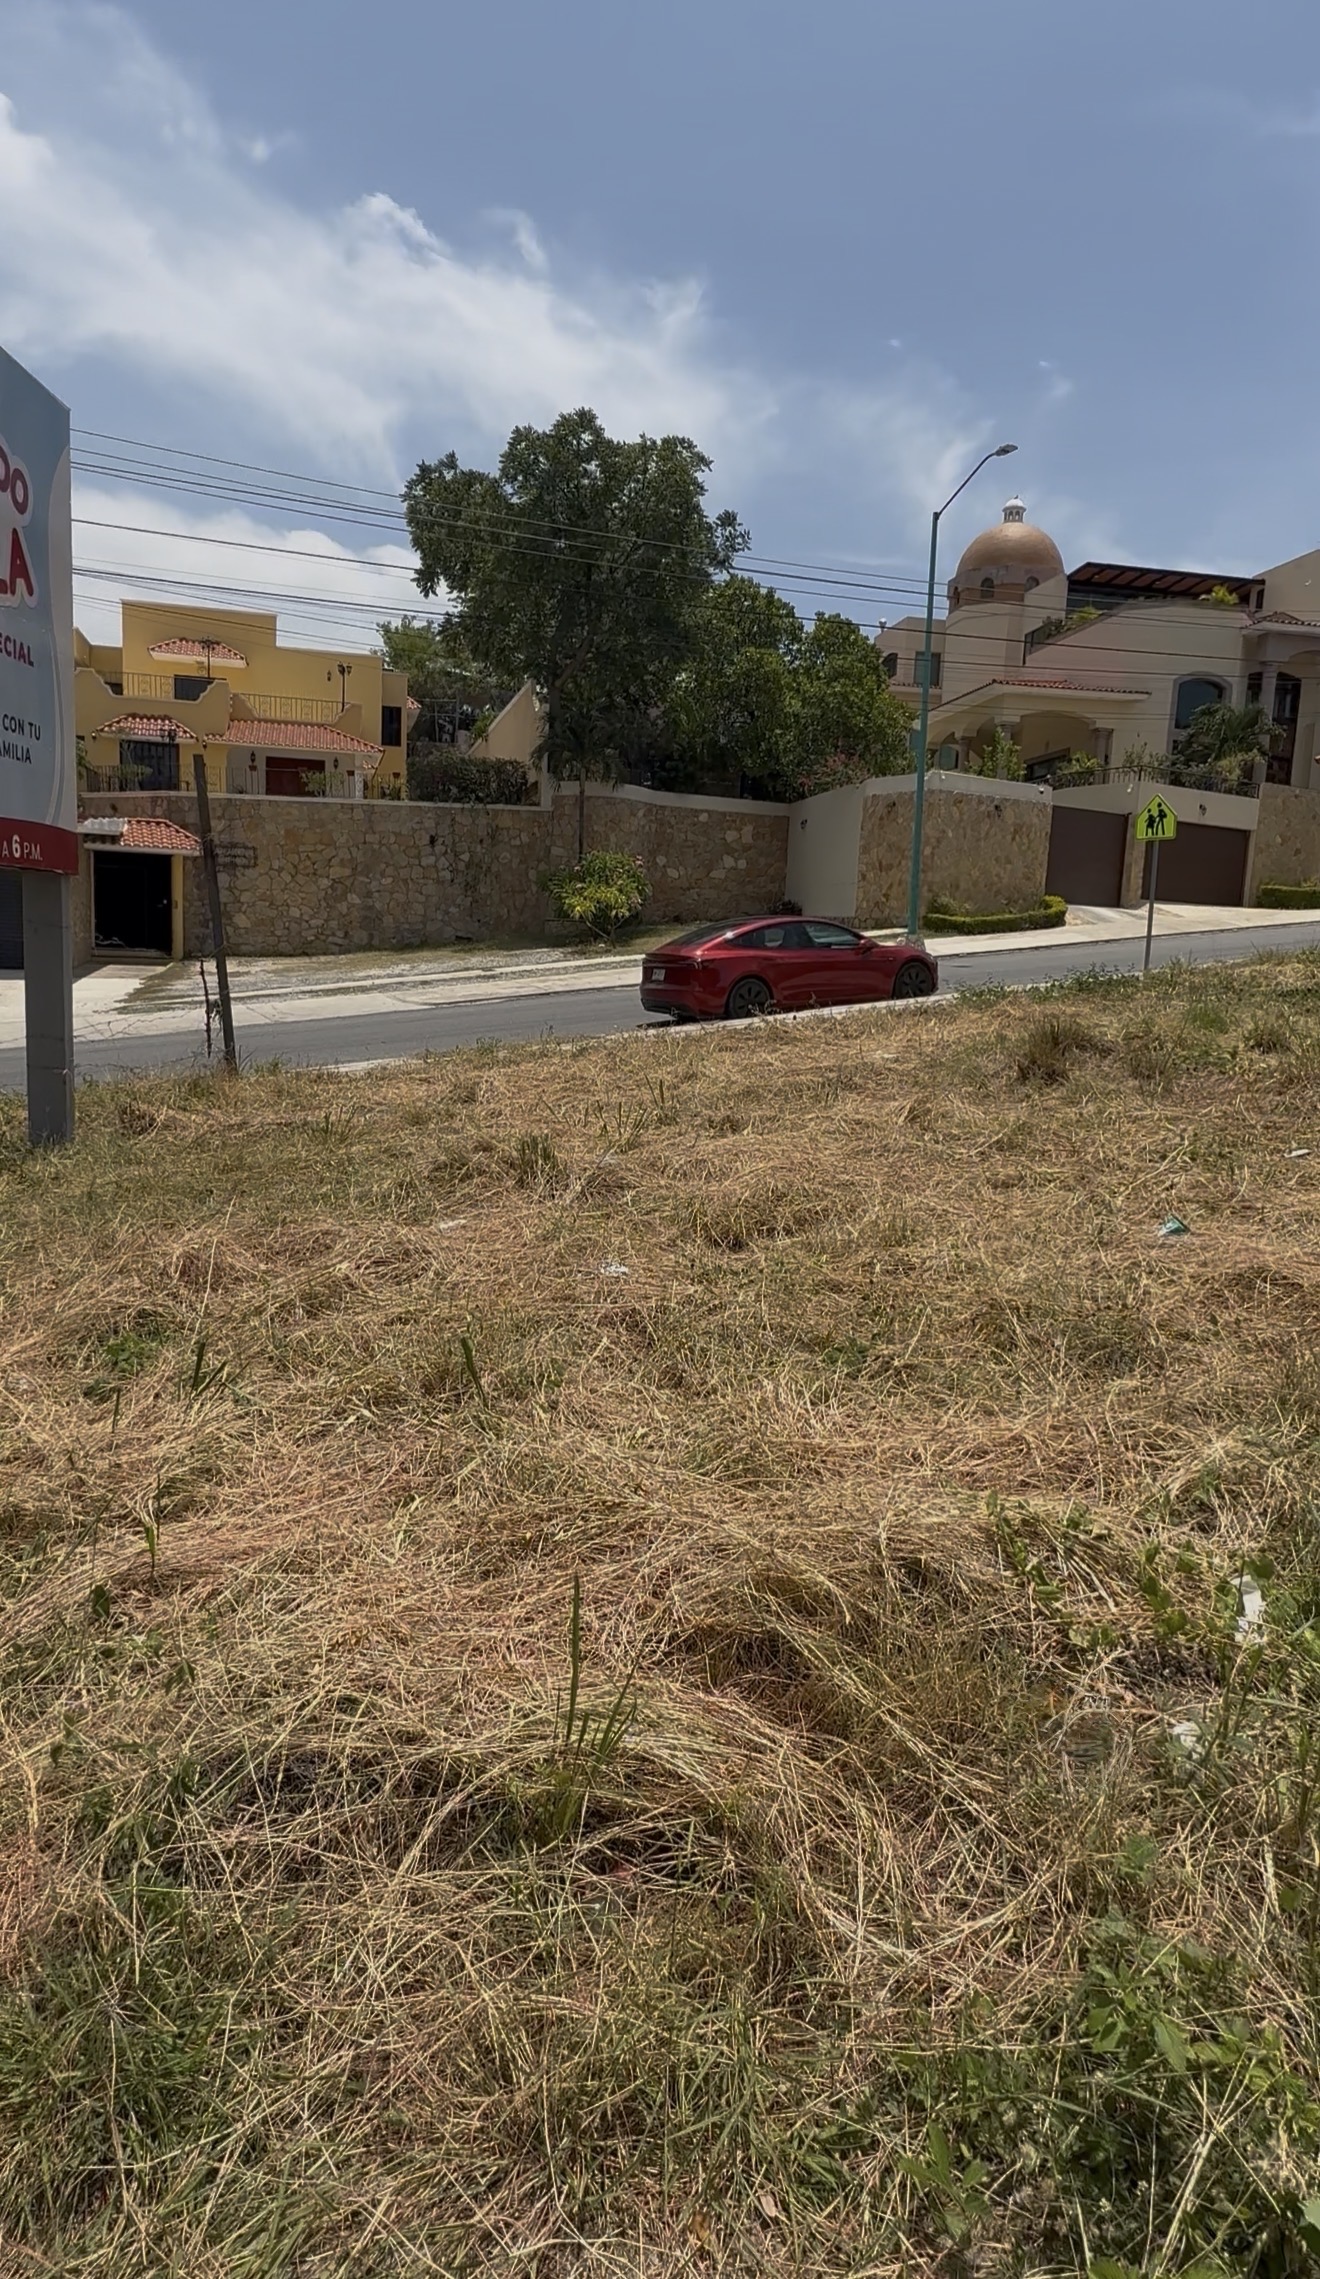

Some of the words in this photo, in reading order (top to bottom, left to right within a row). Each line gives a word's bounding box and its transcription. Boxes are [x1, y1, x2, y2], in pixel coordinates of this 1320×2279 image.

[2, 713, 24, 736] CON
[28, 721, 41, 741] TU
[0, 740, 32, 764] MILIA
[2, 840, 10, 858] A
[12, 834, 21, 858] 6
[23, 841, 43, 861] P.M.
